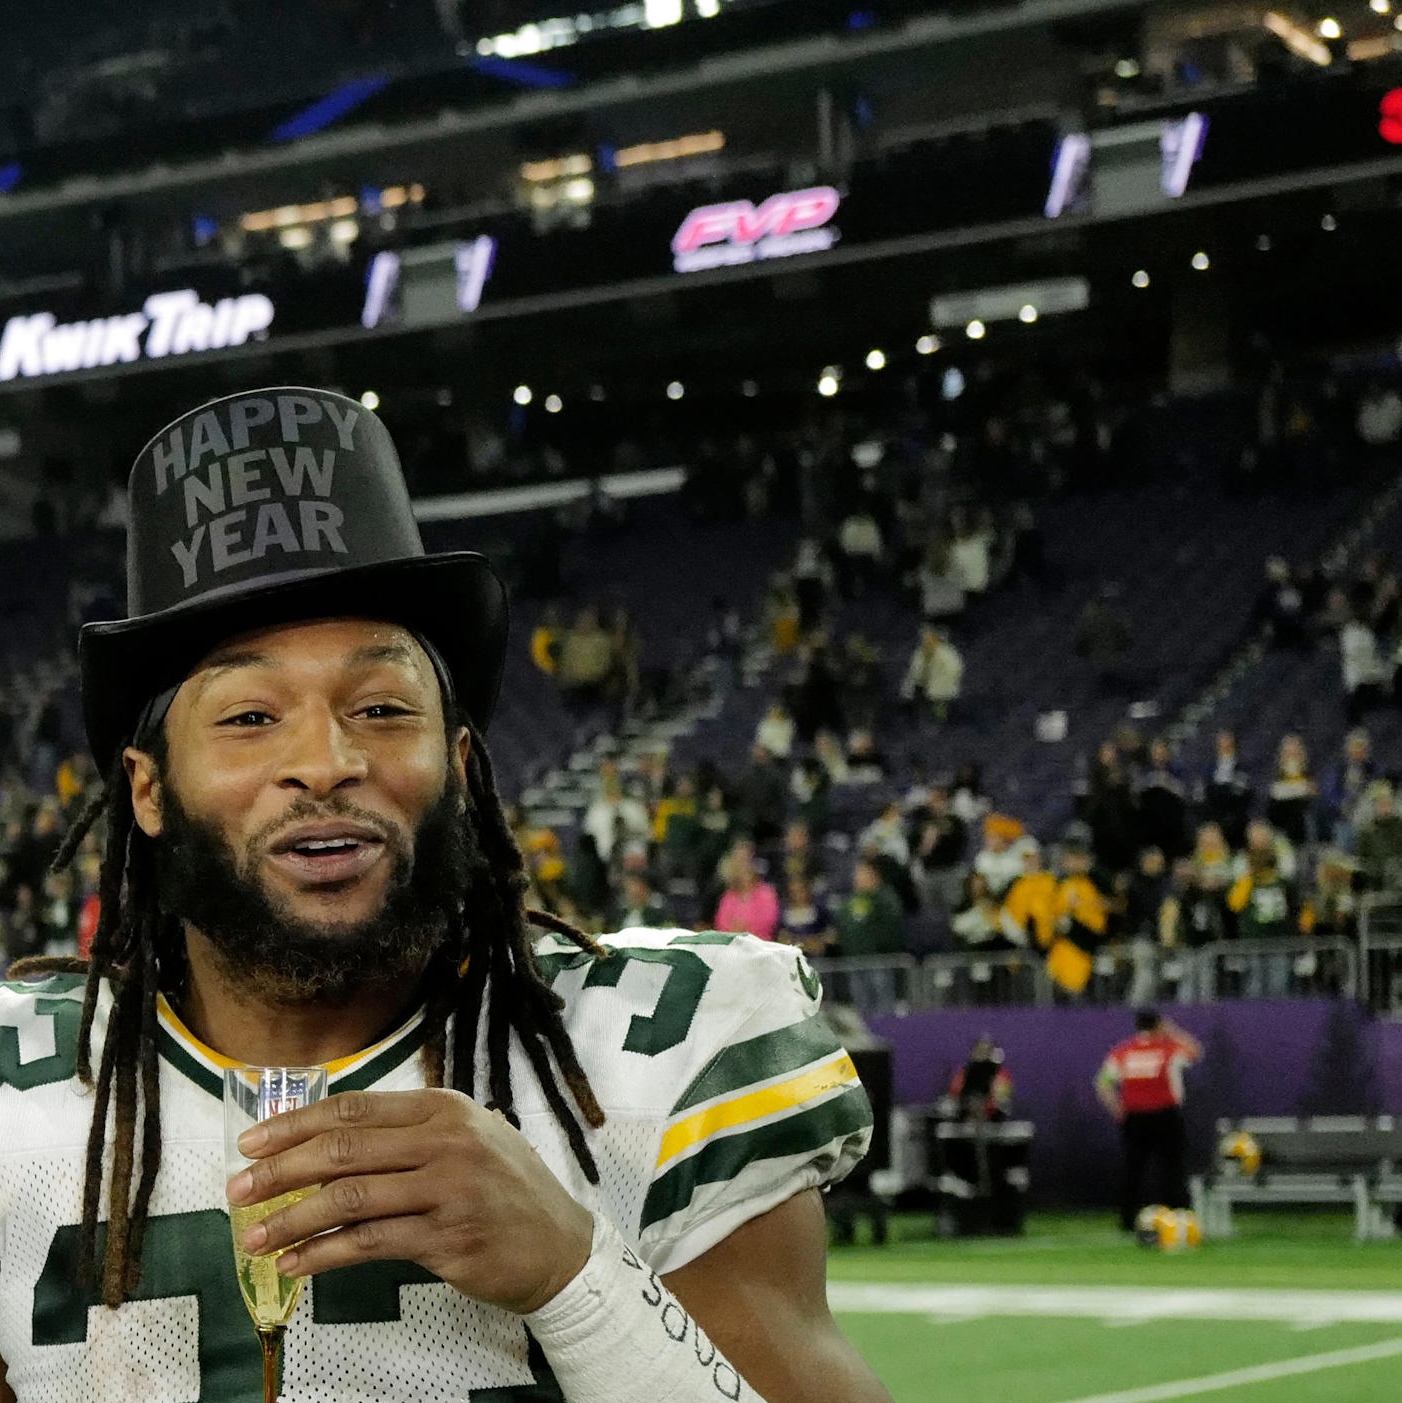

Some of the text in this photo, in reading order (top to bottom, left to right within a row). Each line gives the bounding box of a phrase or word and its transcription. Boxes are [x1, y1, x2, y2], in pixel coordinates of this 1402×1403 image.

[153, 396, 359, 495] HAPPY
[183, 447, 336, 528] NEW
[170, 500, 349, 588] YEAR
